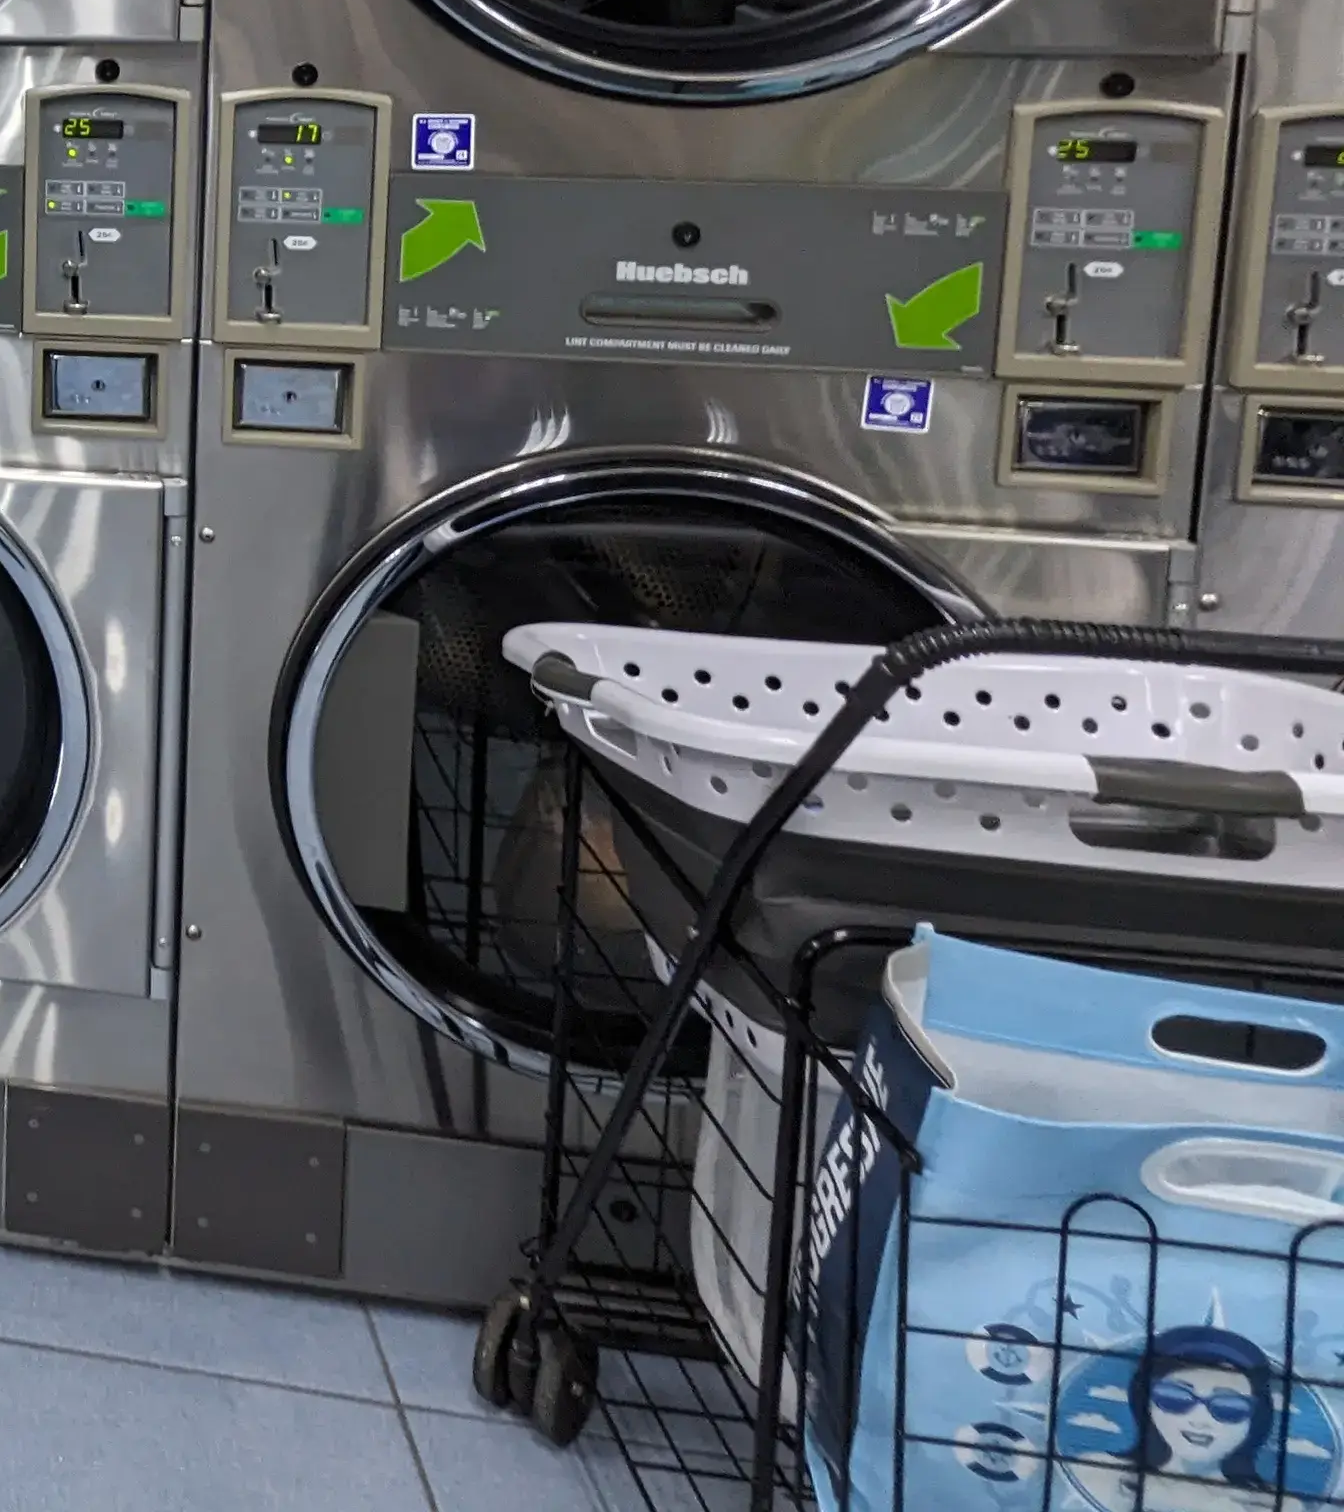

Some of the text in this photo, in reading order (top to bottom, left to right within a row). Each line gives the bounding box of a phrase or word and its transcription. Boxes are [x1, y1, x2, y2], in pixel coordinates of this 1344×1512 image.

[64, 118, 91, 136] 25
[296, 124, 319, 144] 17
[1056, 138, 1090, 159] 25
[615, 260, 749, 286] Huebsch
